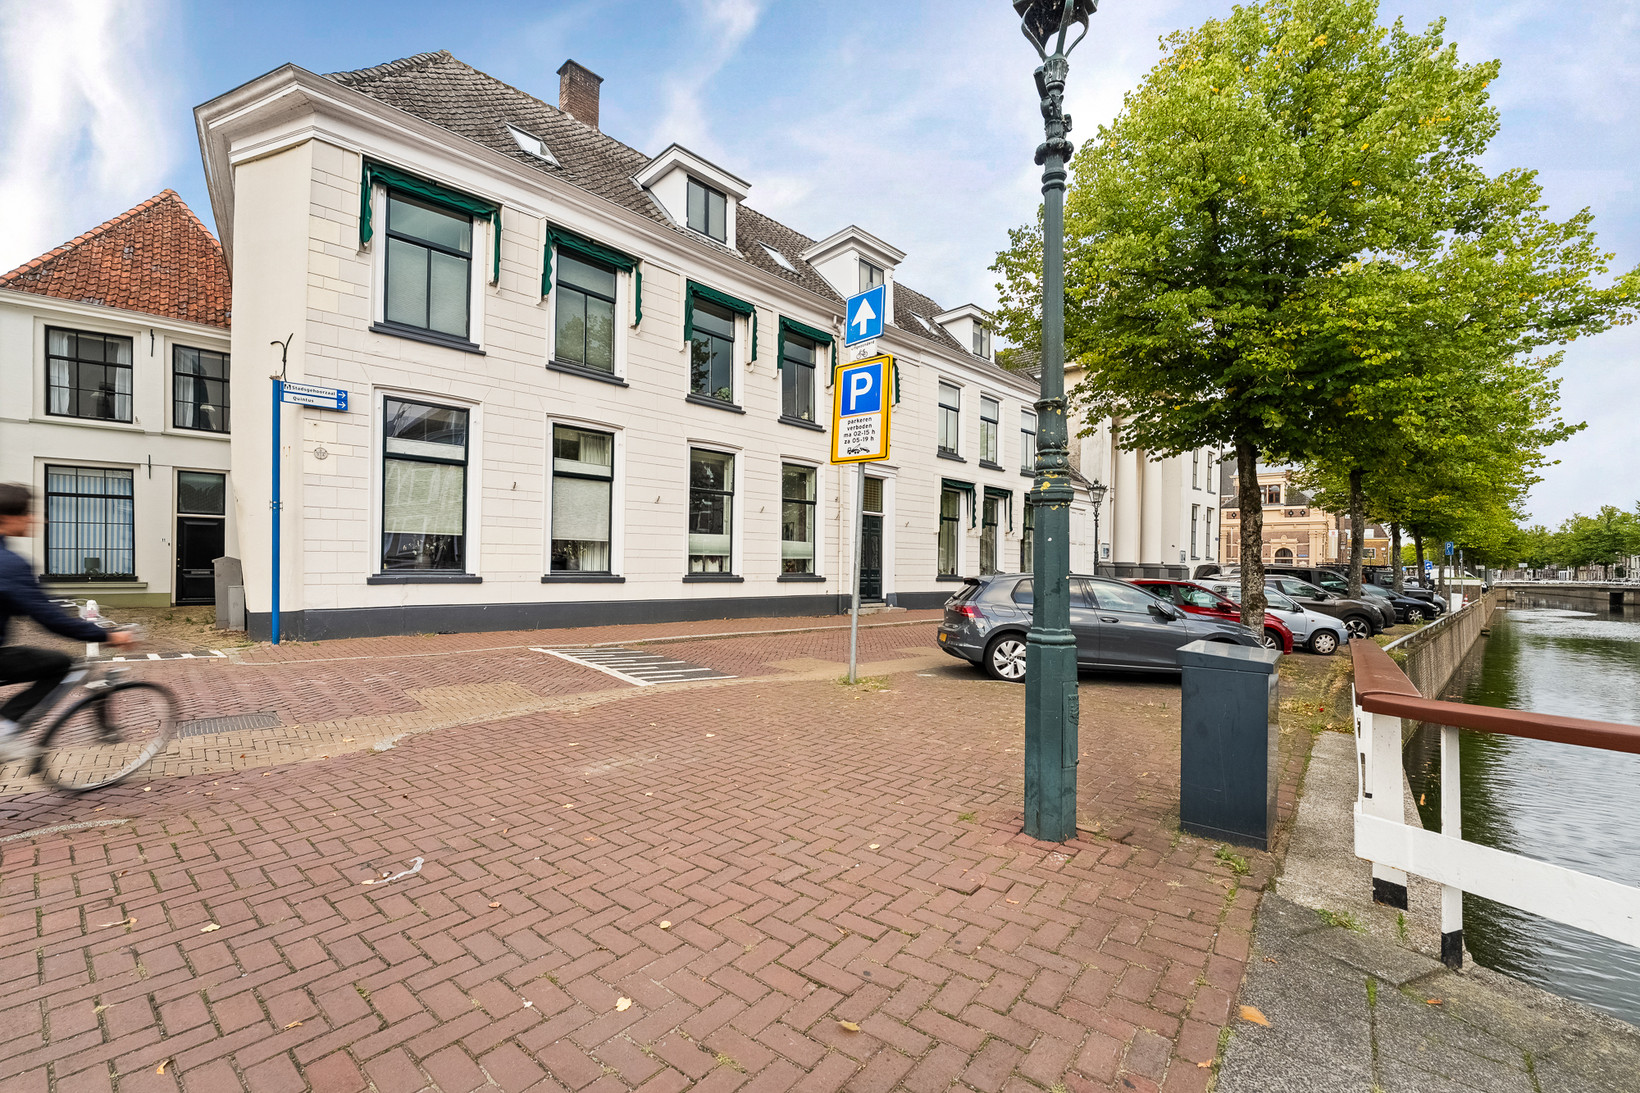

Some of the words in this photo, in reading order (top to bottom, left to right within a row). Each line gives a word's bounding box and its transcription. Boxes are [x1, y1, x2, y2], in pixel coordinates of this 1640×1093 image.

[292, 385, 336, 396] Stadsgehoorzaal
[850, 372, 872, 410] P
[847, 417, 872, 425] parkeren
